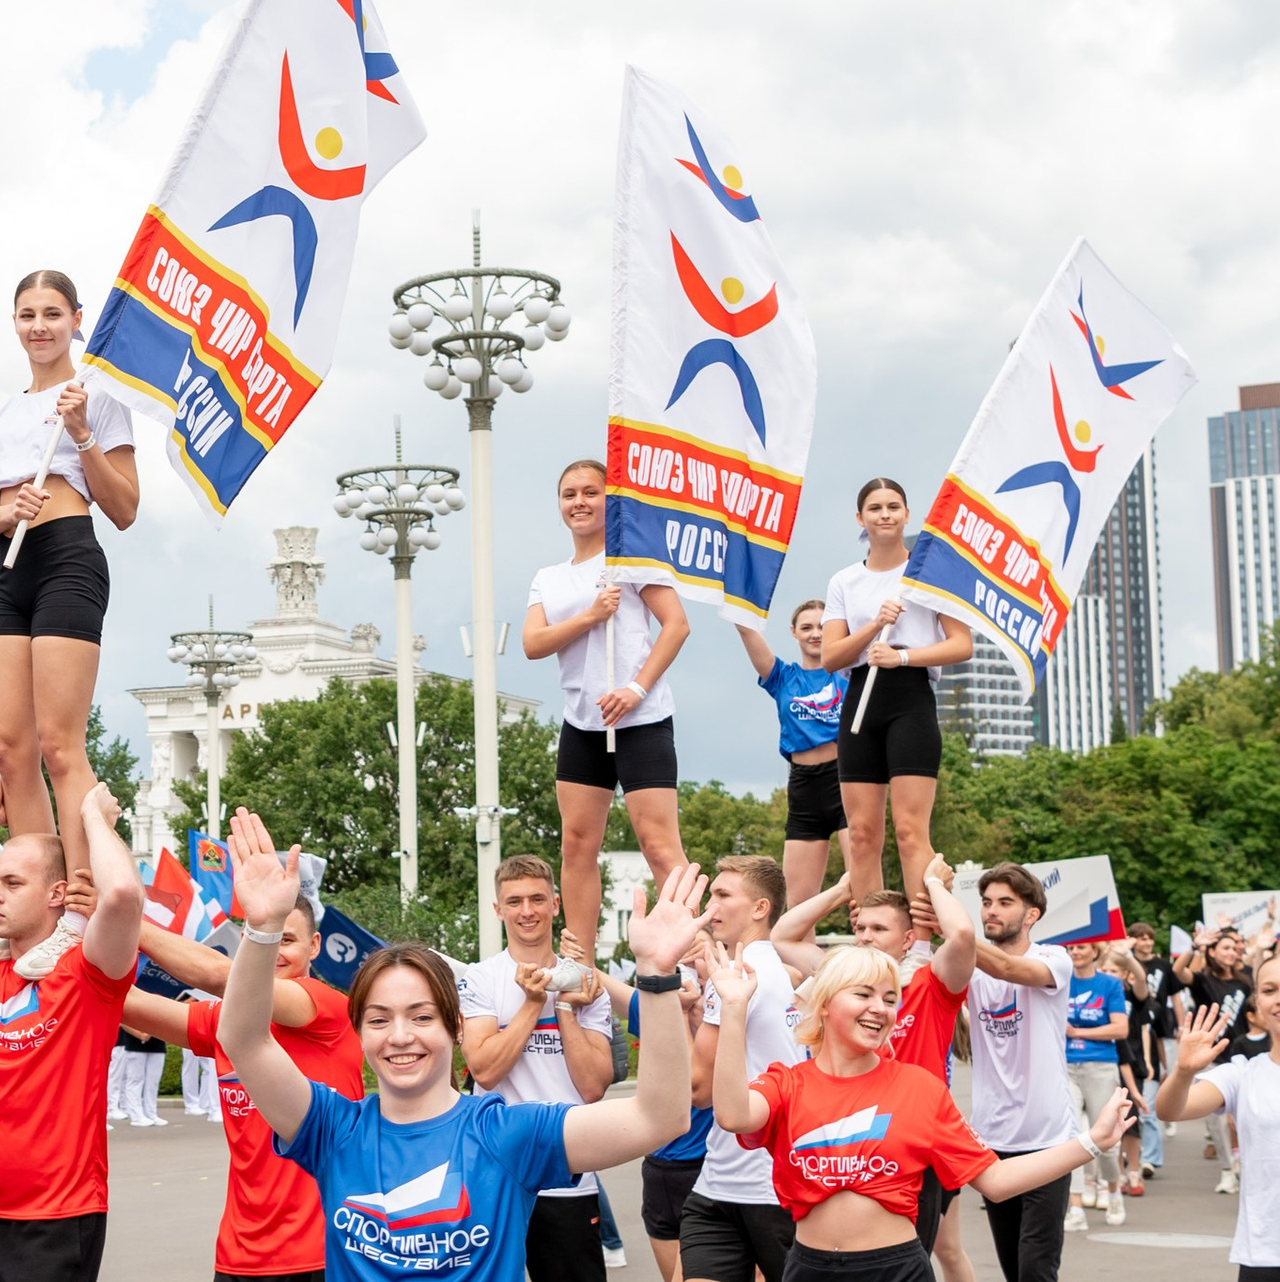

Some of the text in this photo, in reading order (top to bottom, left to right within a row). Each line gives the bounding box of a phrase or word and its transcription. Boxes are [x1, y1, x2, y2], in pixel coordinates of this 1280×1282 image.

[146, 246, 213, 326] СОЮЗ
[207, 297, 258, 361] ЧИР
[627, 442, 785, 533] СОЮЗ ЧИР СПОРТА
[950, 503, 1040, 588] СОЮЗ ЧИР
[344, 1236, 472, 1272] ШЕСТВИЕ
